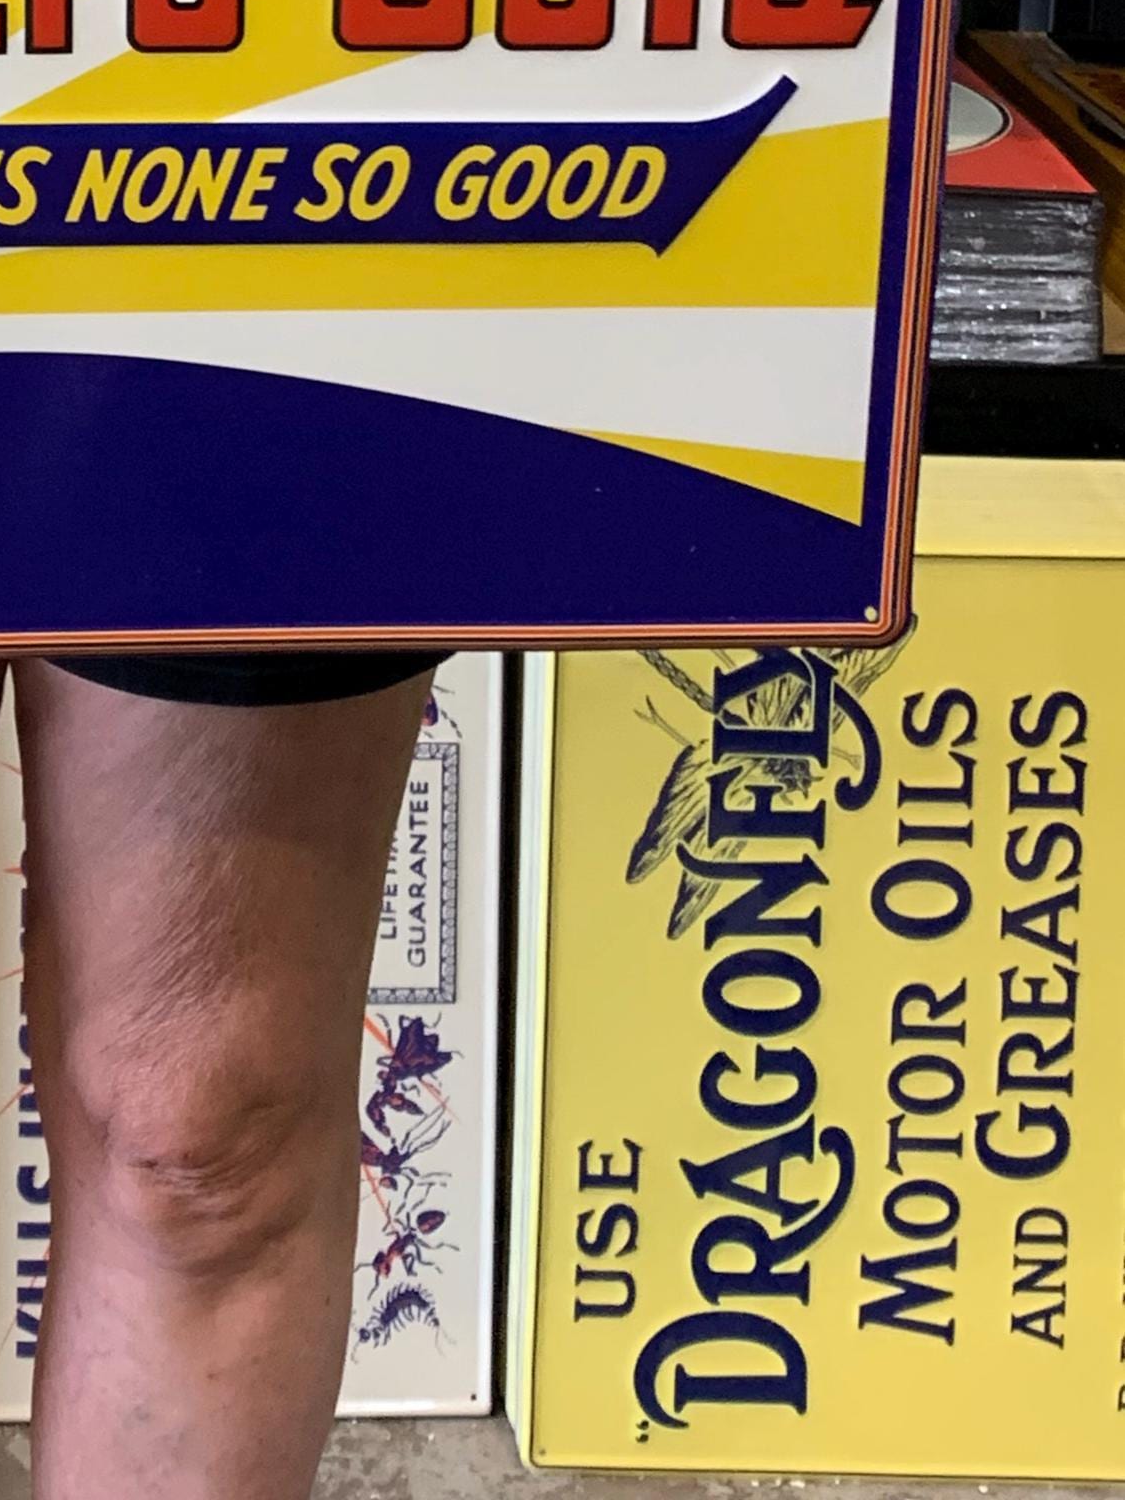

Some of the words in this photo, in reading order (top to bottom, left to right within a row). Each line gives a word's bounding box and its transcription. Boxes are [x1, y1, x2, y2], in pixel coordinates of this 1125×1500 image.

[67, 147, 288, 226] NONE
[294, 144, 411, 224] SO
[434, 145, 669, 221] GOOD
[407, 780, 430, 968] GUARANTEE
[869, 685, 981, 942] OILS
[974, 690, 1090, 1181] GREASES
[574, 1136, 645, 1323] USE
[857, 977, 968, 1347] MOTOR
[1010, 1206, 1070, 1351] AND
